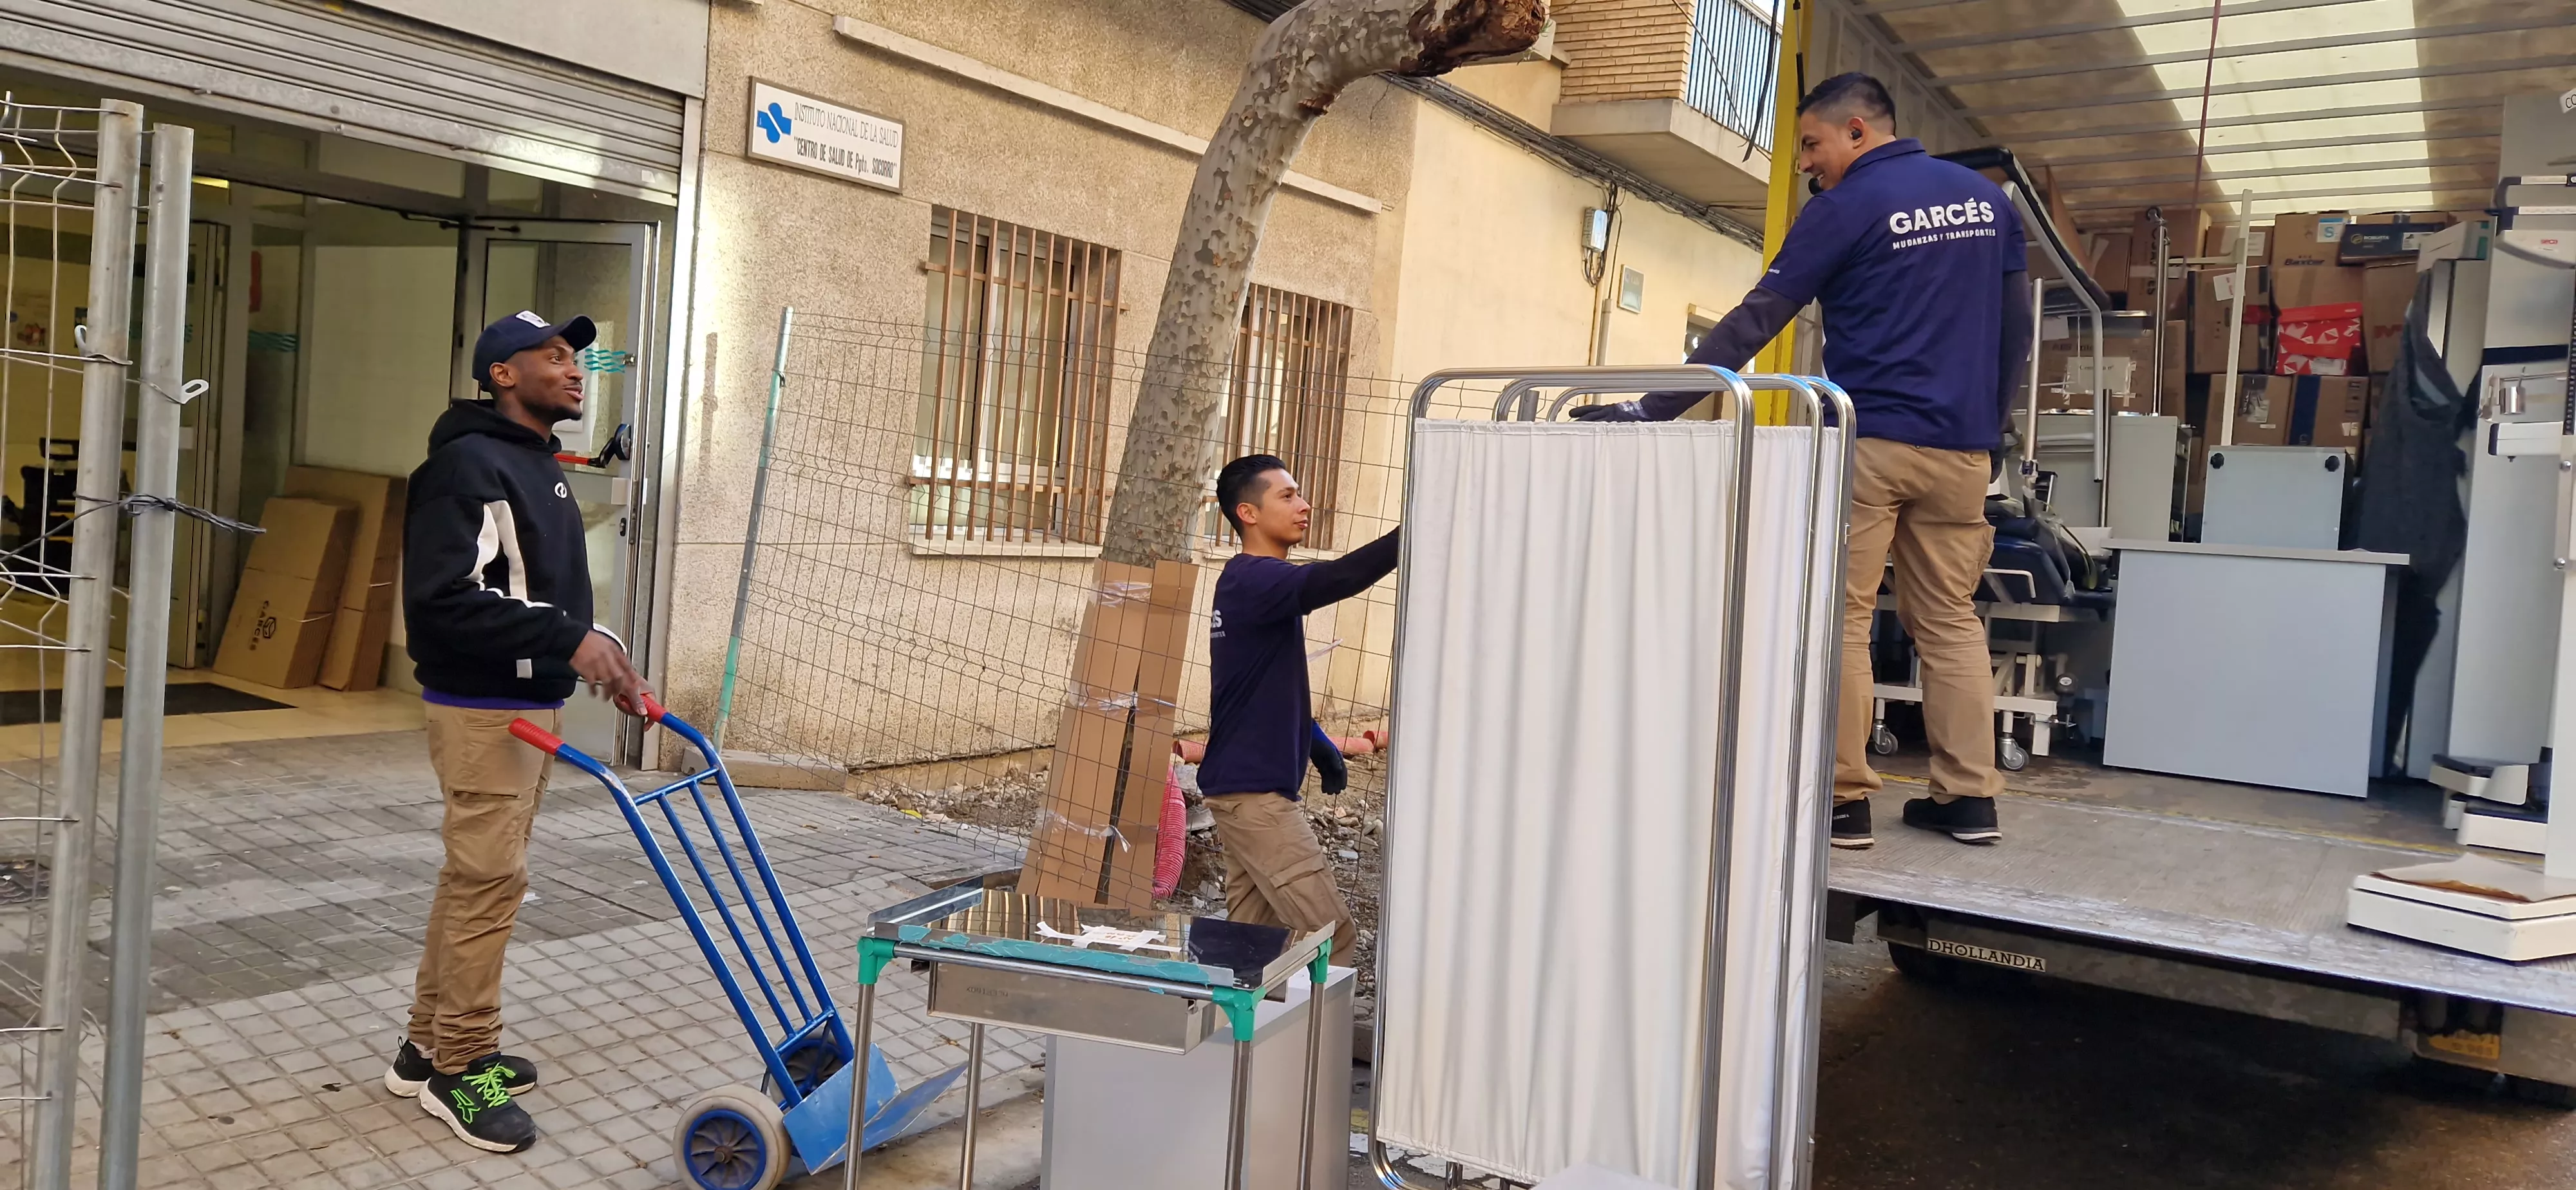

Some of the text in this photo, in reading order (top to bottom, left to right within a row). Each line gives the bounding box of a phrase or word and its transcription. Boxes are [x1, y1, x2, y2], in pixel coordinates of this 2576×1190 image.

[794, 102, 898, 148] INSTITUTO NACIONAL DE LA SALUD
[820, 144, 826, 162] DE
[829, 146, 845, 167] SALUD
[847, 149, 853, 169] DE
[1889, 197, 1994, 234] GARCÉS
[1893, 234, 1938, 250] MUDANZAS
[1946, 229, 1996, 240] TRANSPORTES
[1928, 940, 2044, 970] DHOLLANDIA
